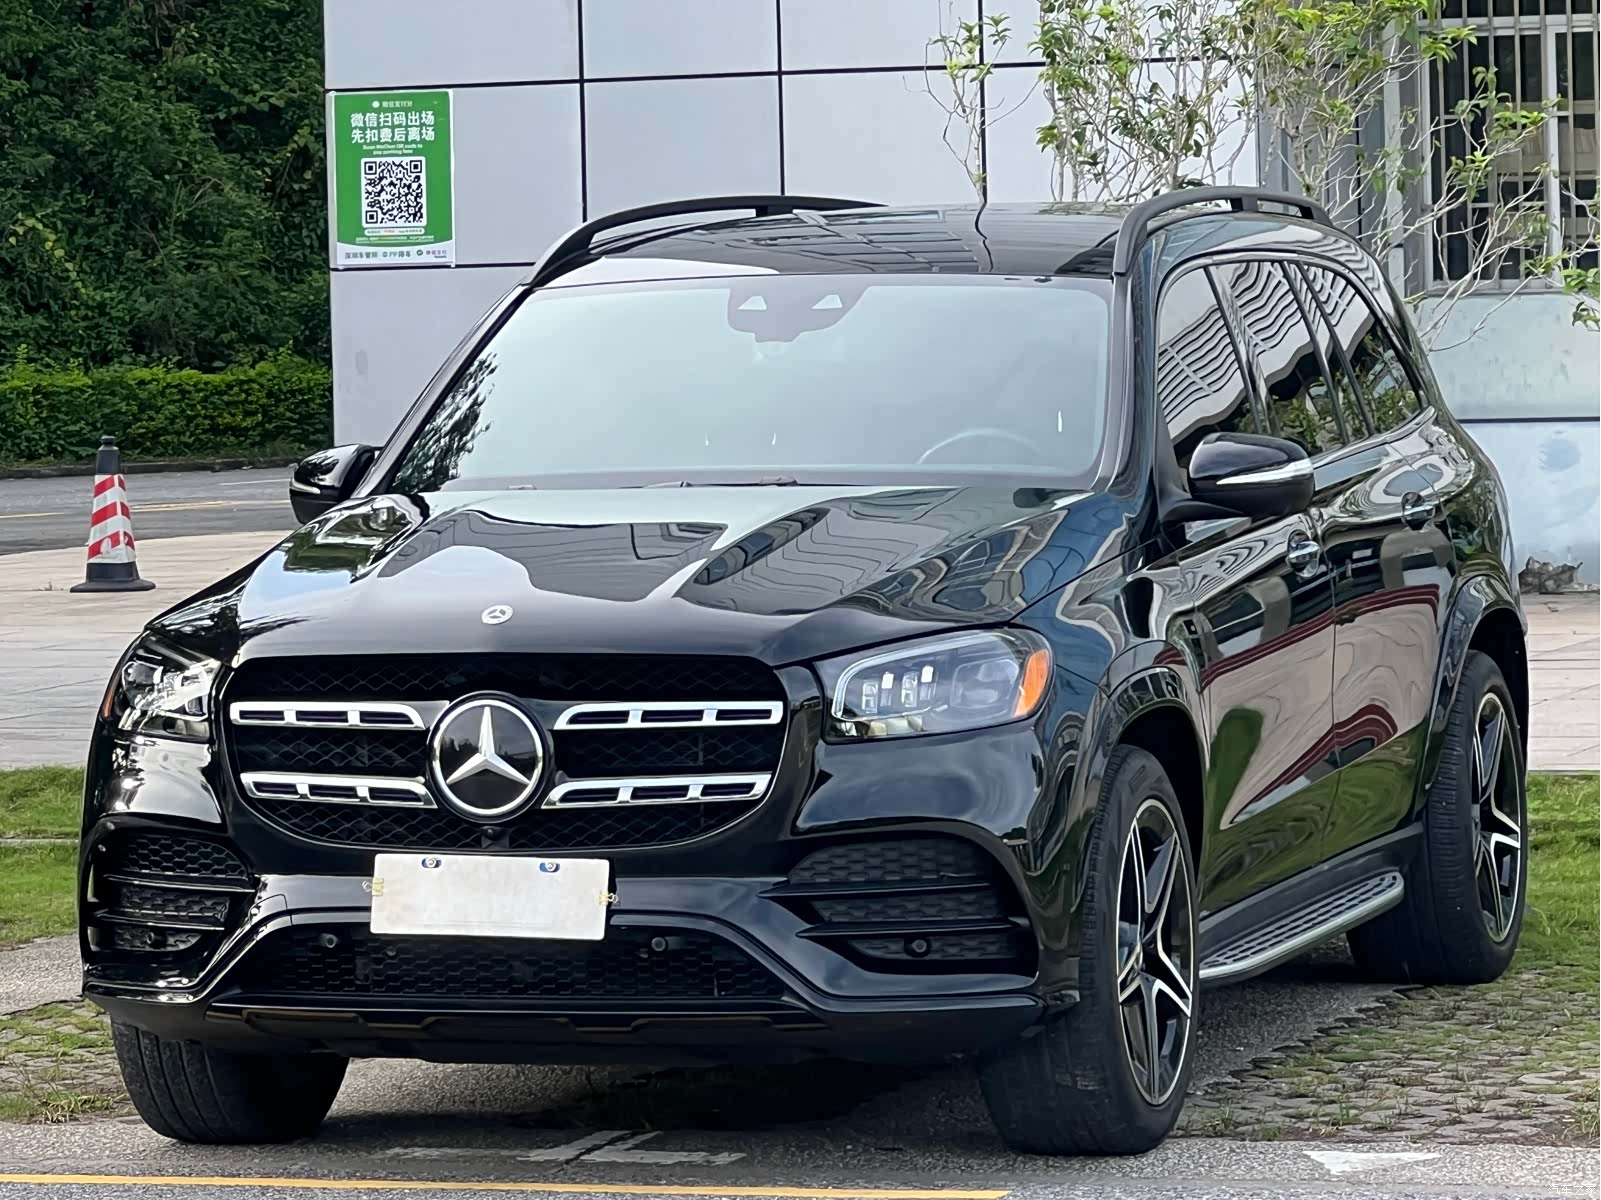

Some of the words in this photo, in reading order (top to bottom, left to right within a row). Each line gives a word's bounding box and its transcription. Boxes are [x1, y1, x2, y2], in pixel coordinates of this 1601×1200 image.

[350, 110, 435, 128] 微信扫码出场
[351, 126, 435, 144] 先扣费后离场
